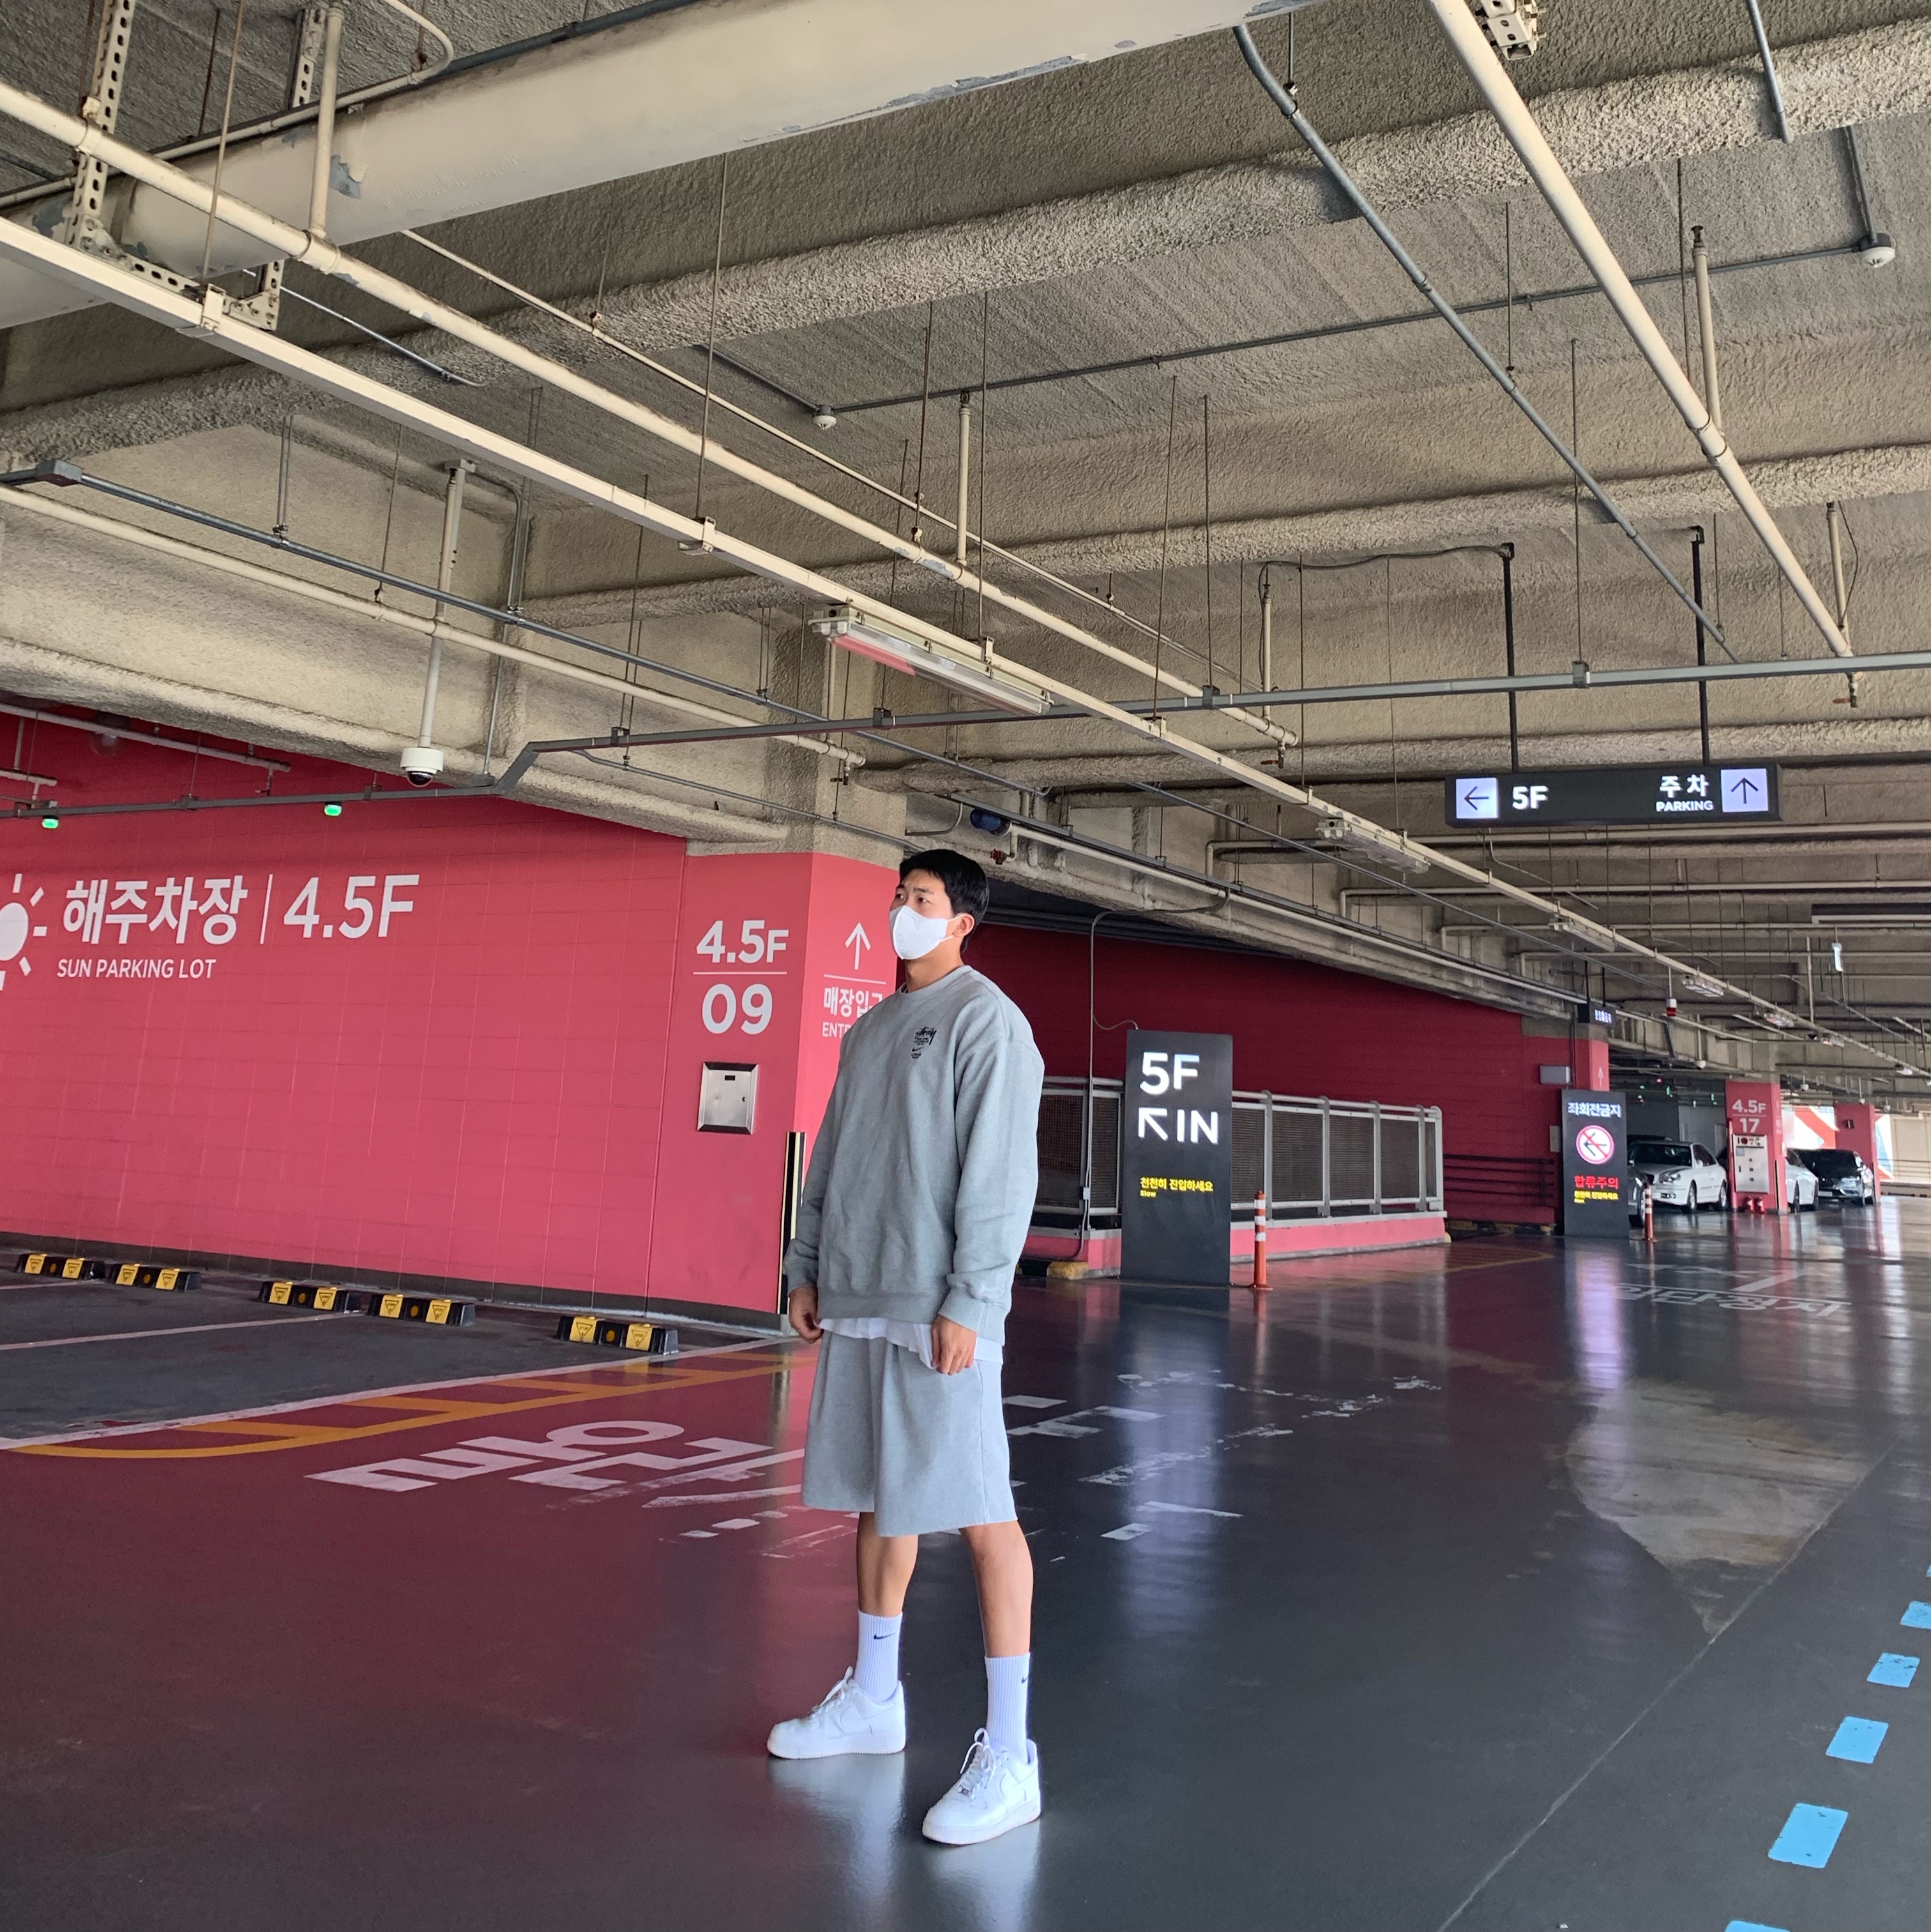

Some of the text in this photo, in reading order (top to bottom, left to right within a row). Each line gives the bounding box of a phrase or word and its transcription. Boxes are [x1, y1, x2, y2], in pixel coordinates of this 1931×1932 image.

[1512, 786, 1548, 810] 5F
[1655, 800, 1714, 812] PARKING
[63, 875, 248, 945] 해주차장
[283, 874, 420, 939] 4.5F
[696, 920, 789, 964] 4.5F
[57, 959, 216, 978] SUN PARKING LOT
[702, 984, 773, 1035] 09
[1139, 1052, 1200, 1095] 5F
[1568, 1102, 1622, 1118] 좌회전금지
[1732, 1099, 1766, 1113] 4.5F
[1176, 1109, 1219, 1145] IN
[1739, 1118, 1760, 1133] 17
[1140, 1177, 1214, 1192] 천천히 진입하세요
